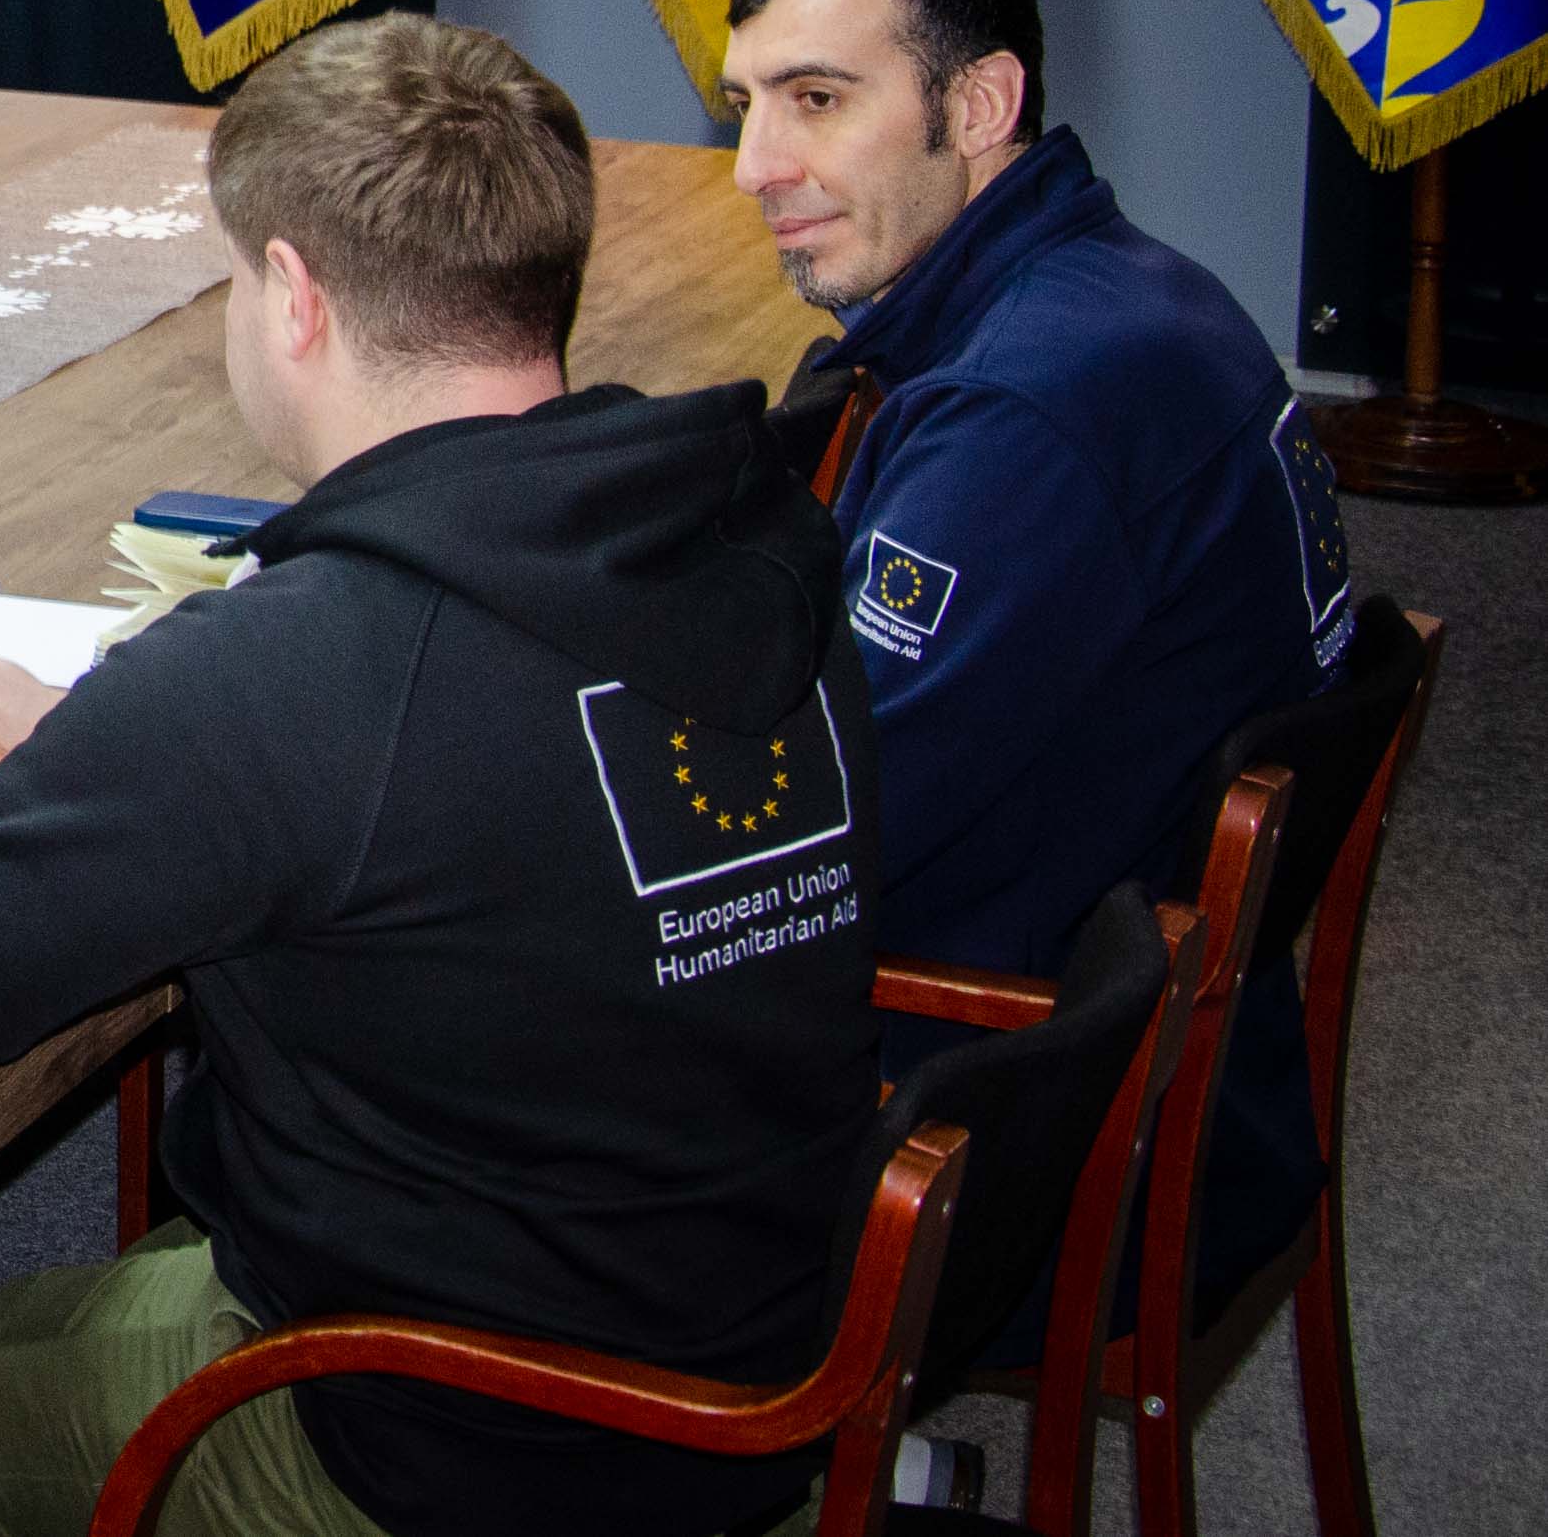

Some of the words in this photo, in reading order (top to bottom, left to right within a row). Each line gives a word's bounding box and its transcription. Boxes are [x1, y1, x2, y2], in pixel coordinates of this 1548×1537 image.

[890, 623, 921, 645] Union
[900, 645, 921, 661] Aid
[658, 886, 781, 943] European
[786, 863, 850, 904] Union
[655, 914, 825, 987] Humanitarian
[831, 892, 858, 930] Aid
